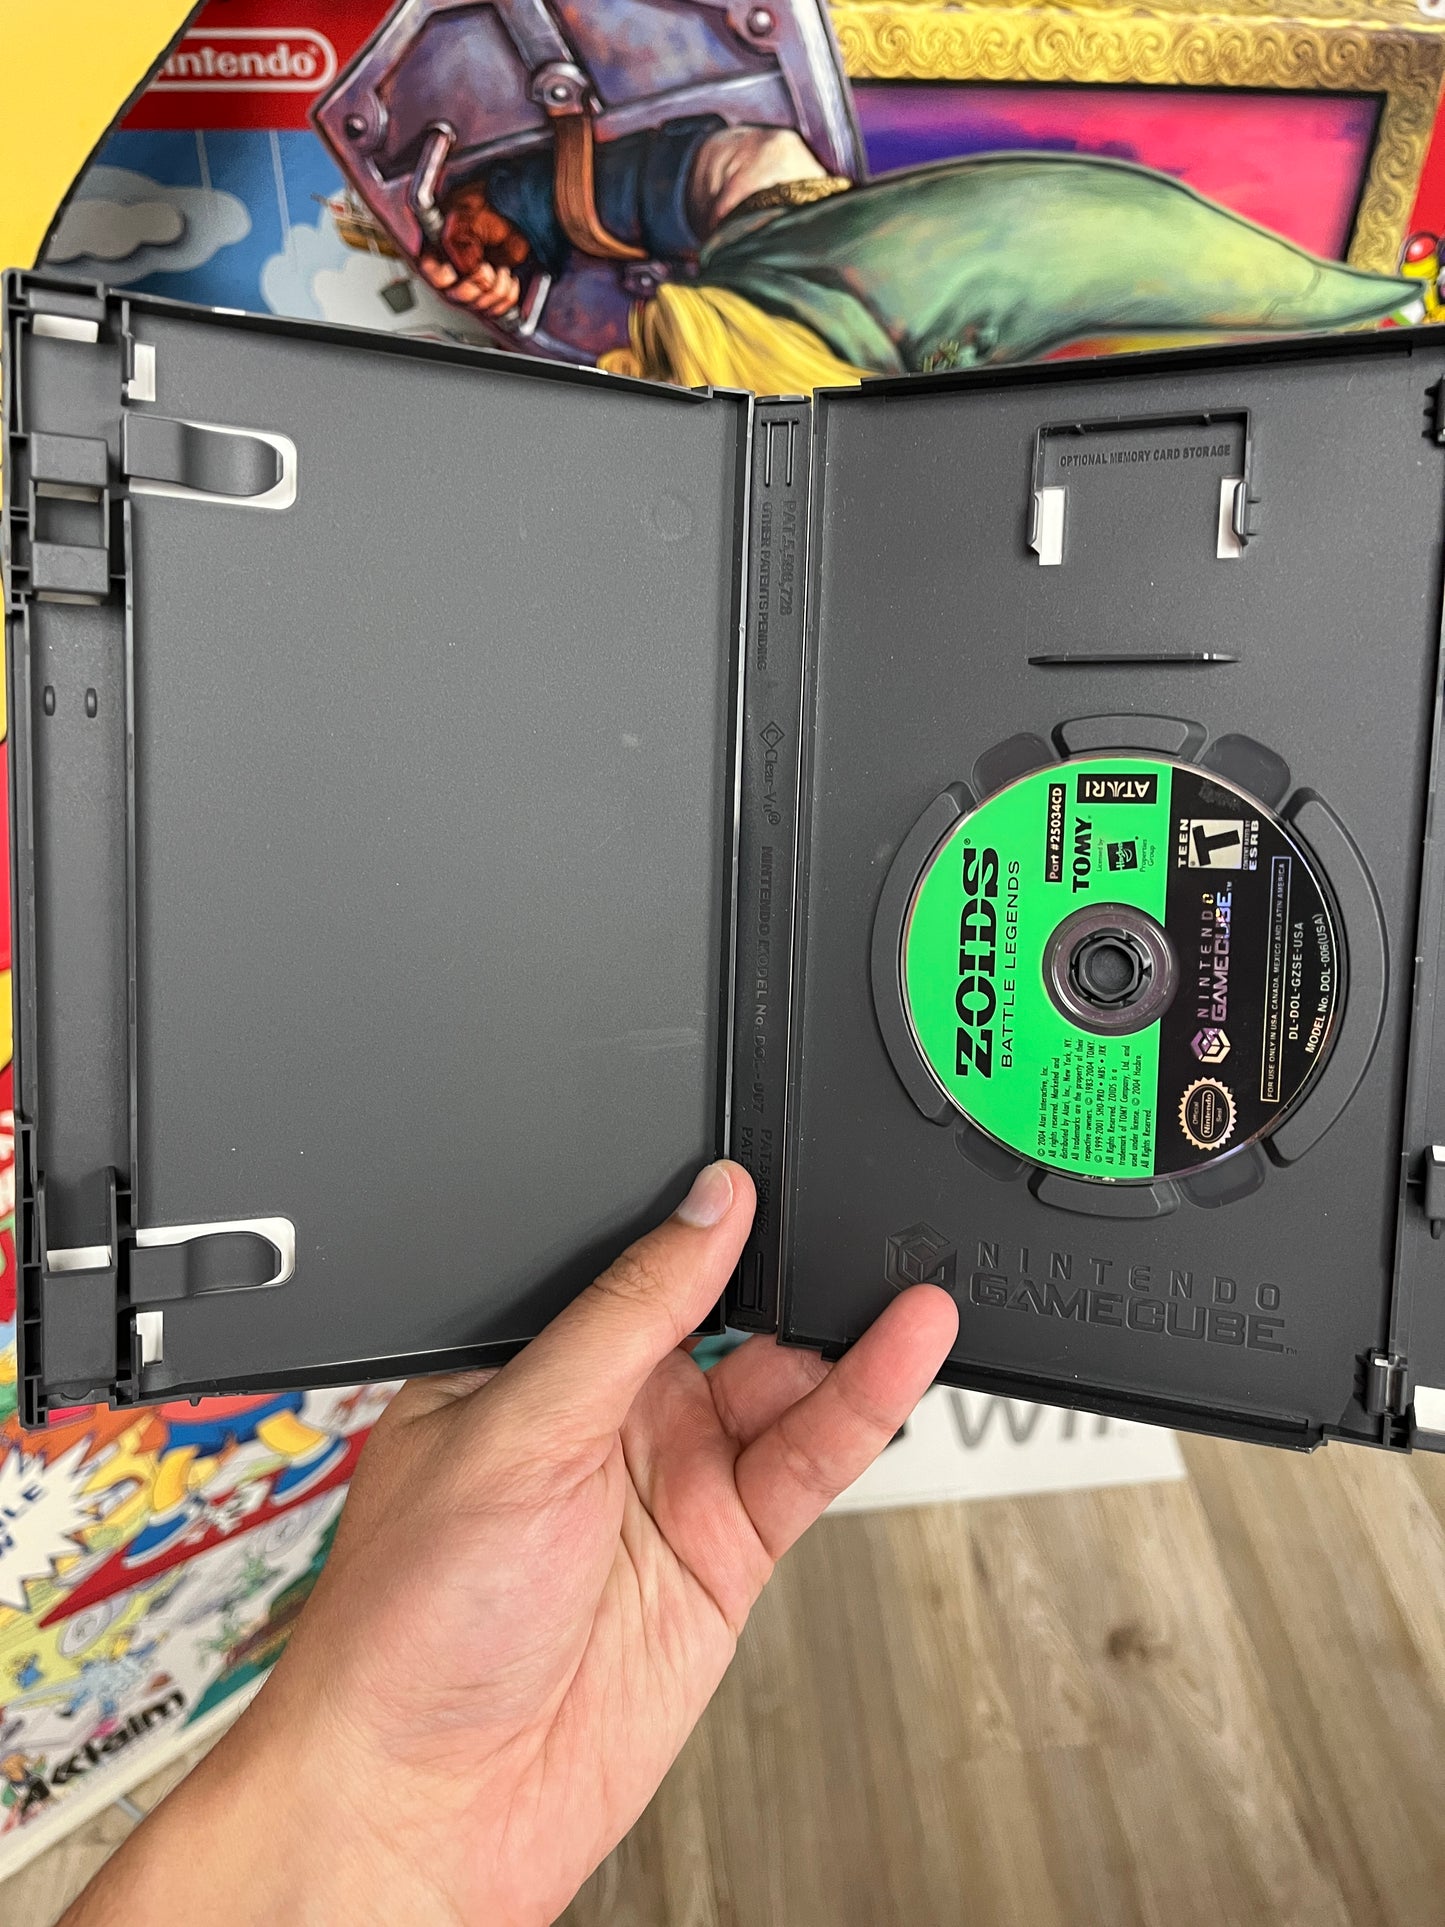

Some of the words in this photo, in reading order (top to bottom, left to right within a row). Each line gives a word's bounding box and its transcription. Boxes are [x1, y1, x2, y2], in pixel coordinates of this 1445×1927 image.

[158, 43, 317, 78] intendo
[1060, 454, 1107, 467] OPTIONAL
[1110, 451, 1149, 465] MEMORY
[1154, 448, 1180, 461] CARD
[1183, 445, 1230, 459] STORAGE
[761, 502, 772, 548] OTHER
[759, 550, 771, 610] PATENTS
[757, 612, 768, 671] PENDING
[1086, 781, 1150, 797] ATARI
[1050, 788, 1062, 850] #25034CD
[1072, 817, 1092, 893] TOMY
[1178, 819, 1189, 868] TEEN
[1192, 825, 1240, 866] T
[1249, 820, 1259, 870] ESRB
[1050, 855, 1059, 879] Part
[759, 846, 774, 936] NINTENDO
[1005, 861, 1019, 968] LEGENDS
[1197, 893, 1214, 1017] NINTENDO
[1273, 943, 1281, 973] MEXICO
[1312, 914, 1330, 992] DOL-006(USA)
[755, 941, 770, 999] MODEL
[1289, 922, 1304, 1040] DL-DOL-GZSE-USA
[754, 1004, 767, 1030] No.
[1317, 995, 1328, 1012] No.
[1002, 979, 1015, 1068] BATTLE
[1271, 1032, 1276, 1040] IN
[1304, 1015, 1326, 1053] MODEL
[1064, 1052, 1072, 1066] York,
[1075, 1039, 1083, 1052] their
[1122, 1046, 1130, 1056] and
[1051, 1072, 1059, 1099] Marketed
[1063, 1070, 1071, 1081] New
[1086, 1062, 1094, 1094] 1983-2004
[1120, 1075, 1130, 1102] Company,
[1132, 1079, 1140, 1095] 2004
[1074, 1092, 1082, 1101] the
[1096, 1090, 1105, 1116] SHO-PRO
[1108, 1084, 1117, 1101] ZOIDS
[1038, 1114, 1046, 1128] Atari
[1108, 1105, 1116, 1133] Reserved.
[1119, 1106, 1127, 1122] TOMY
[1130, 1110, 1139, 1130] license.
[1143, 1109, 1151, 1136] Reserved.
[1049, 1132, 1058, 1147] rights
[1060, 1129, 1068, 1159] distributed
[1072, 1118, 1080, 1150] trademarks
[1084, 1134, 1092, 1161] respective
[1095, 1120, 1104, 1152] 1999-2001
[1107, 1137, 1116, 1153] Rights
[1130, 1134, 1138, 1150] under
[1142, 1140, 1151, 1157] Rights
[977, 1240, 1281, 1311] NINTENDO
